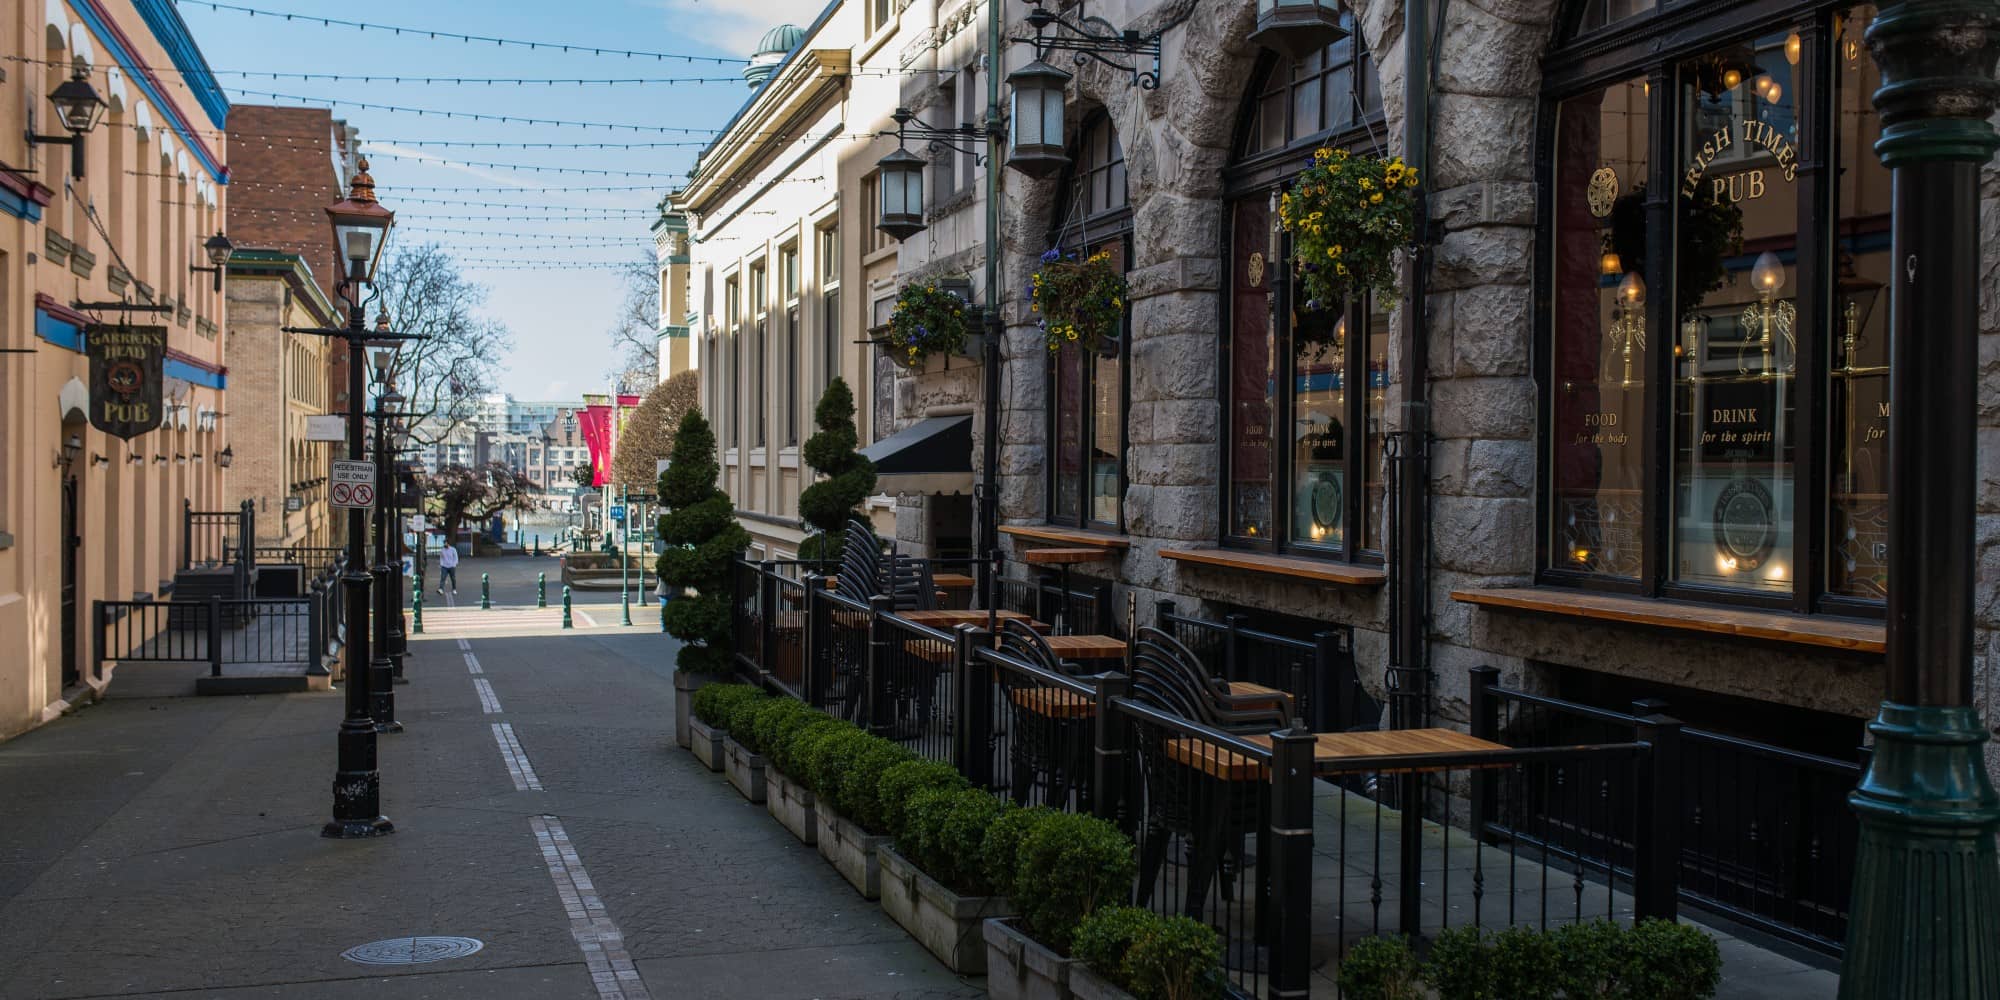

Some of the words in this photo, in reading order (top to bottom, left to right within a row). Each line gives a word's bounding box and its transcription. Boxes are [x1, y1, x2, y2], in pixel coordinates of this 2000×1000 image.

[1682, 126, 1731, 199] IRISH
[1743, 120, 1799, 182] TIMES
[1712, 170, 1766, 206] PUB
[105, 346, 146, 359] HEAD
[104, 402, 149, 422] PUB
[1585, 413, 1617, 426] FOOD
[1712, 408, 1758, 423] DRINK
[1608, 432, 1628, 446] body
[1700, 431, 1716, 445] for
[1721, 430, 1737, 442] the
[1742, 431, 1772, 445] spirit
[1865, 426, 1886, 442] for
[334, 463, 373, 472] PEDESTRIAN
